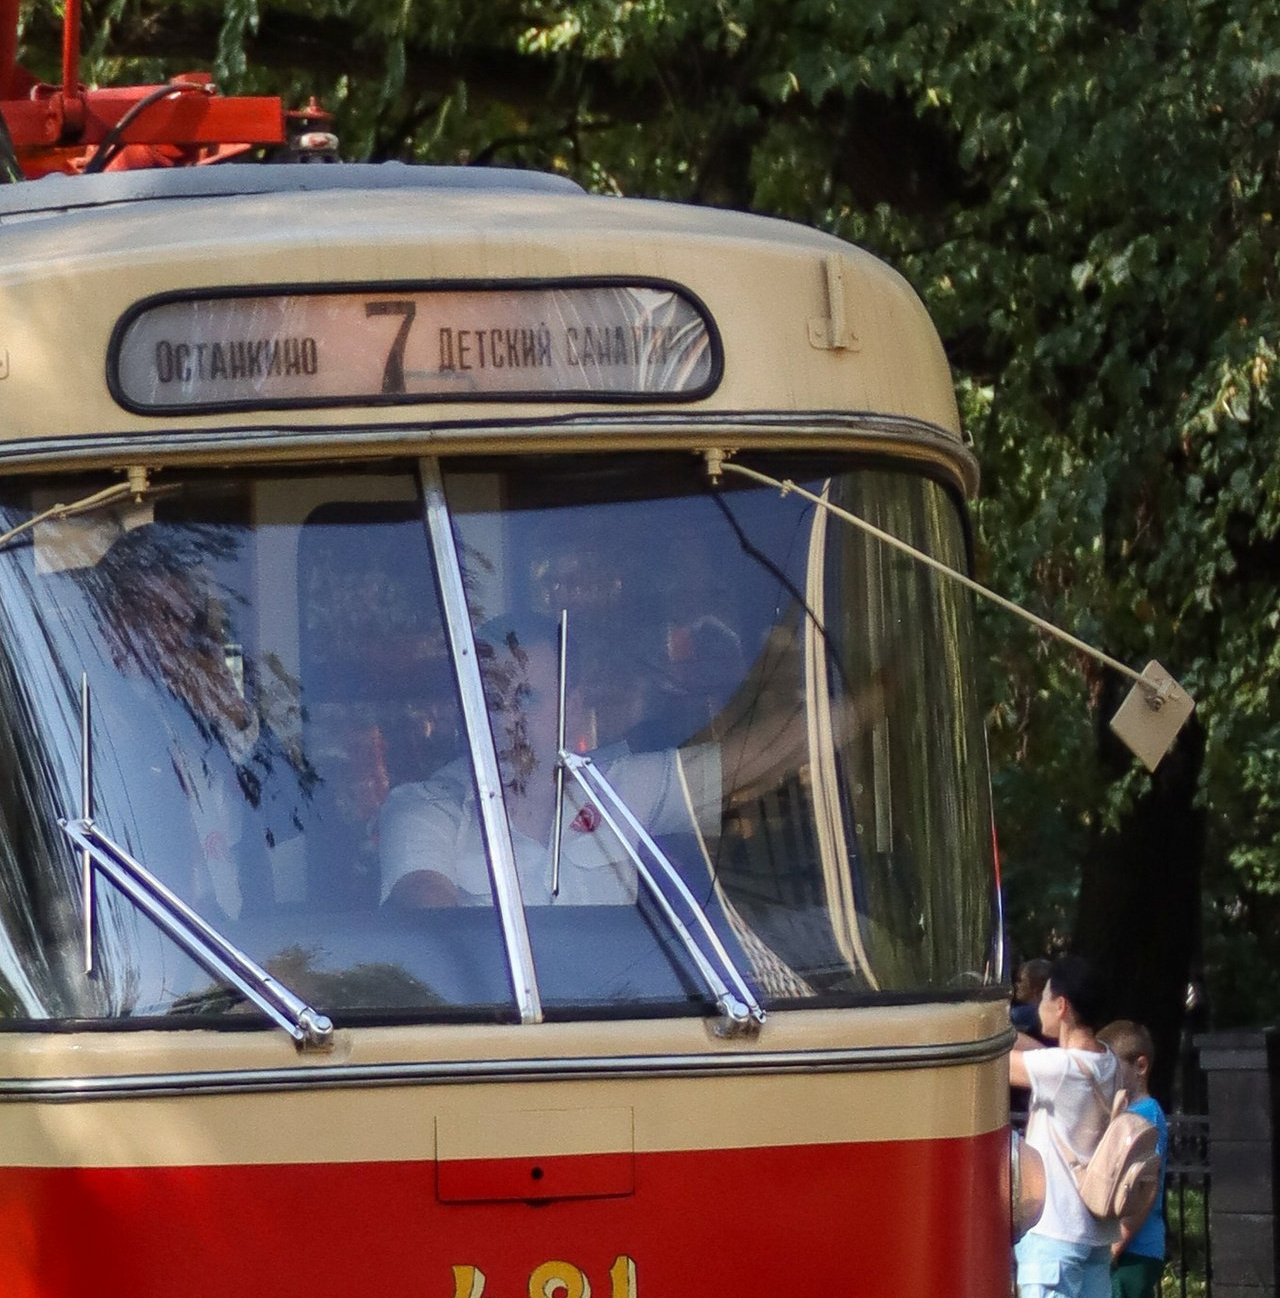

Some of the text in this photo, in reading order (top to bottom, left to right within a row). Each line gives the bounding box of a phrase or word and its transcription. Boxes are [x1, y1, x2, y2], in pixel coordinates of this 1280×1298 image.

[155, 337, 319, 384] ОСТАНКИНО
[365, 300, 417, 393] 7
[439, 322, 552, 372] ДЕТСКИЙ
